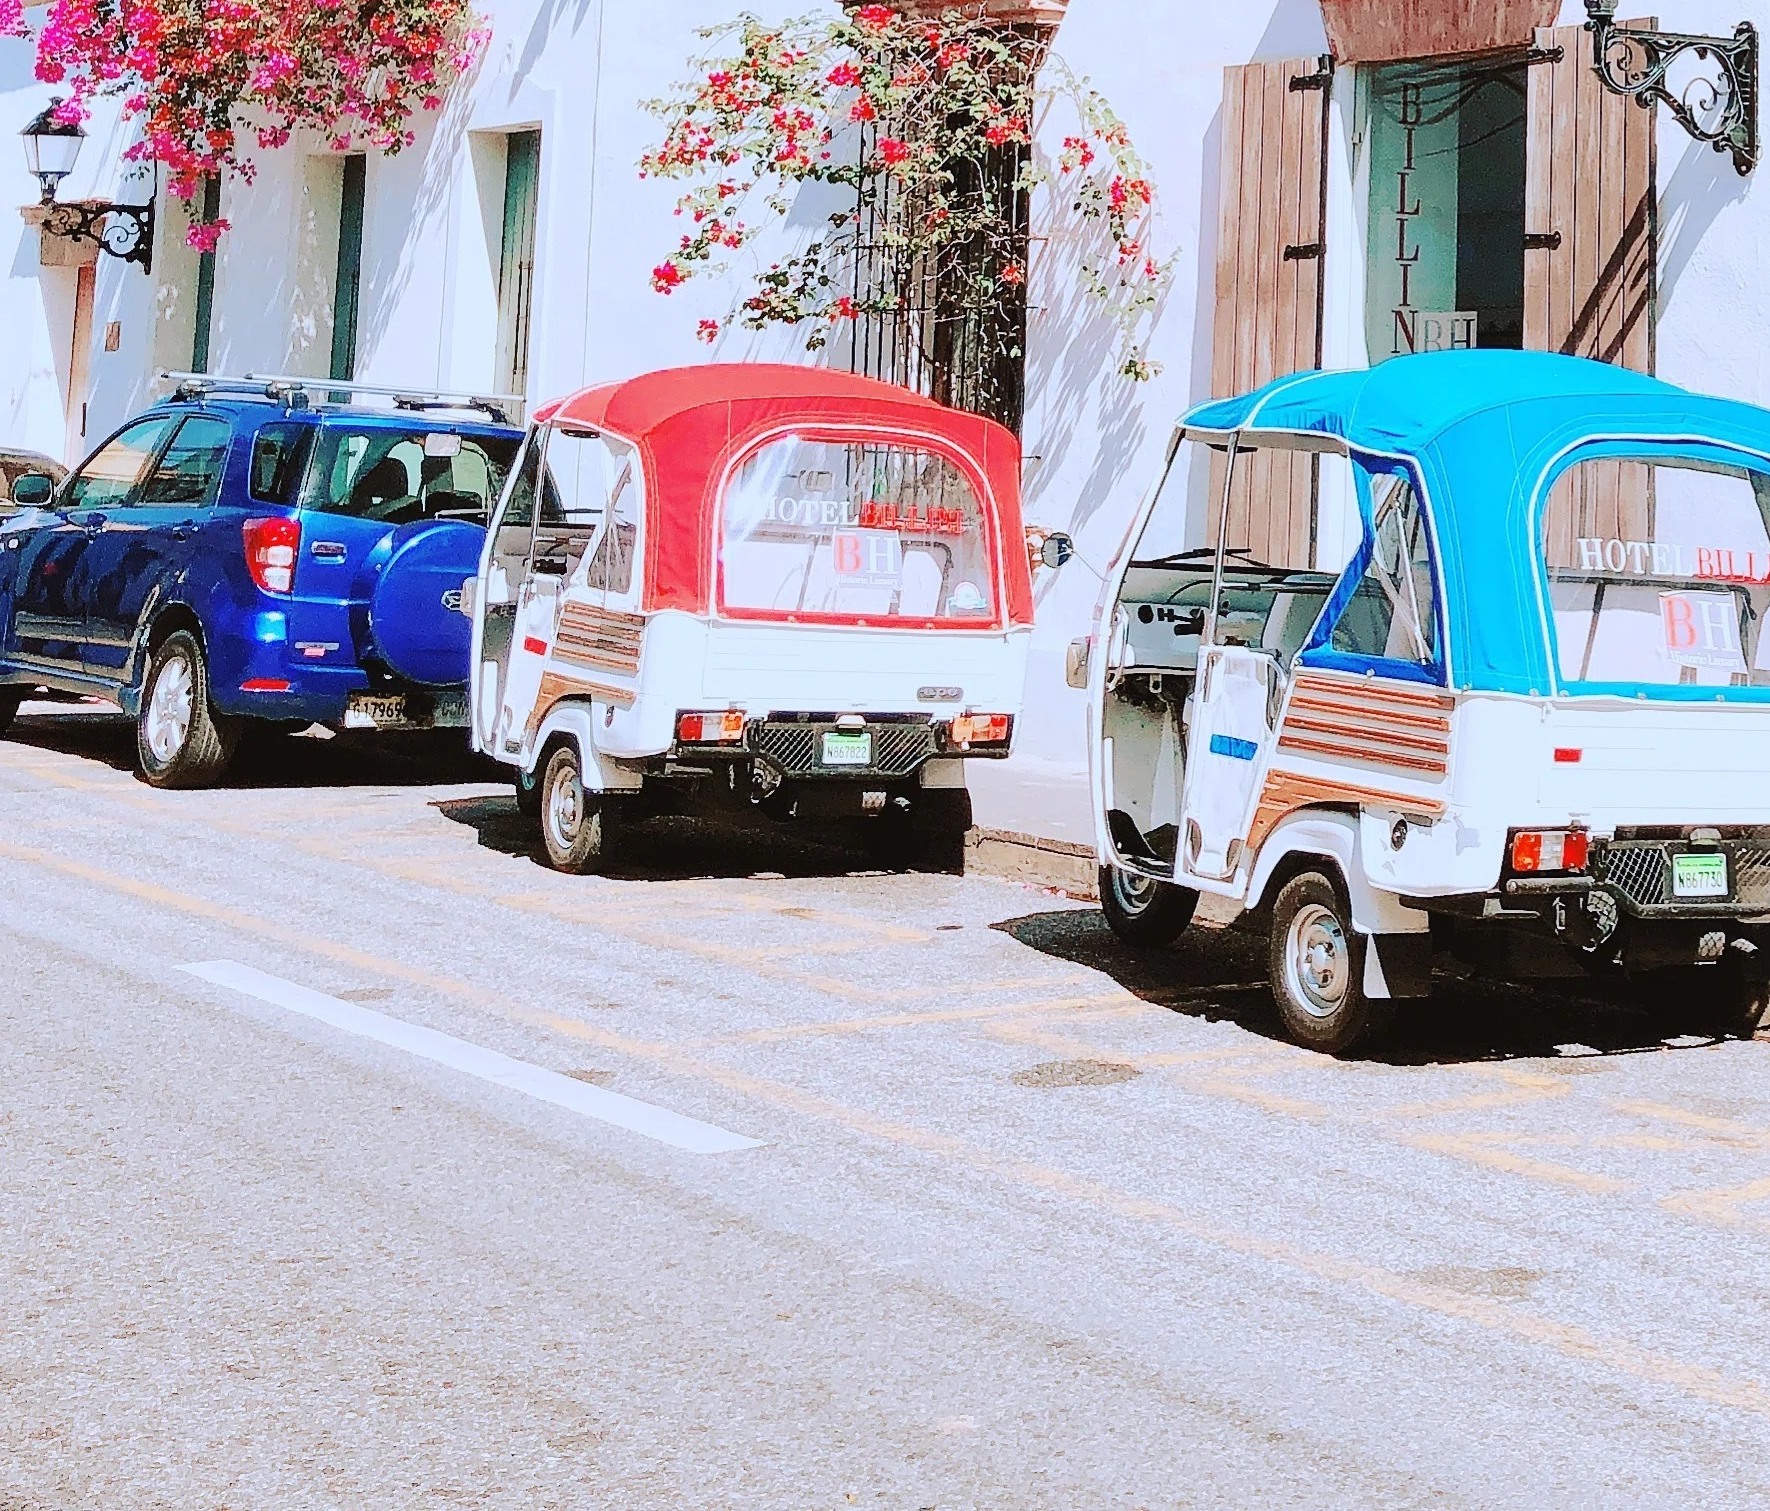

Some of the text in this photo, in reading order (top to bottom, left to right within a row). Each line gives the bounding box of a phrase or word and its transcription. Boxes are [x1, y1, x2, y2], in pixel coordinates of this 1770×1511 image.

[1391, 83, 1424, 354] BILLIN
[836, 535, 899, 575] BH
[1577, 538, 1694, 576] HOTEL
[1663, 596, 1738, 653] BH
[1678, 871, 1723, 889] N867730
